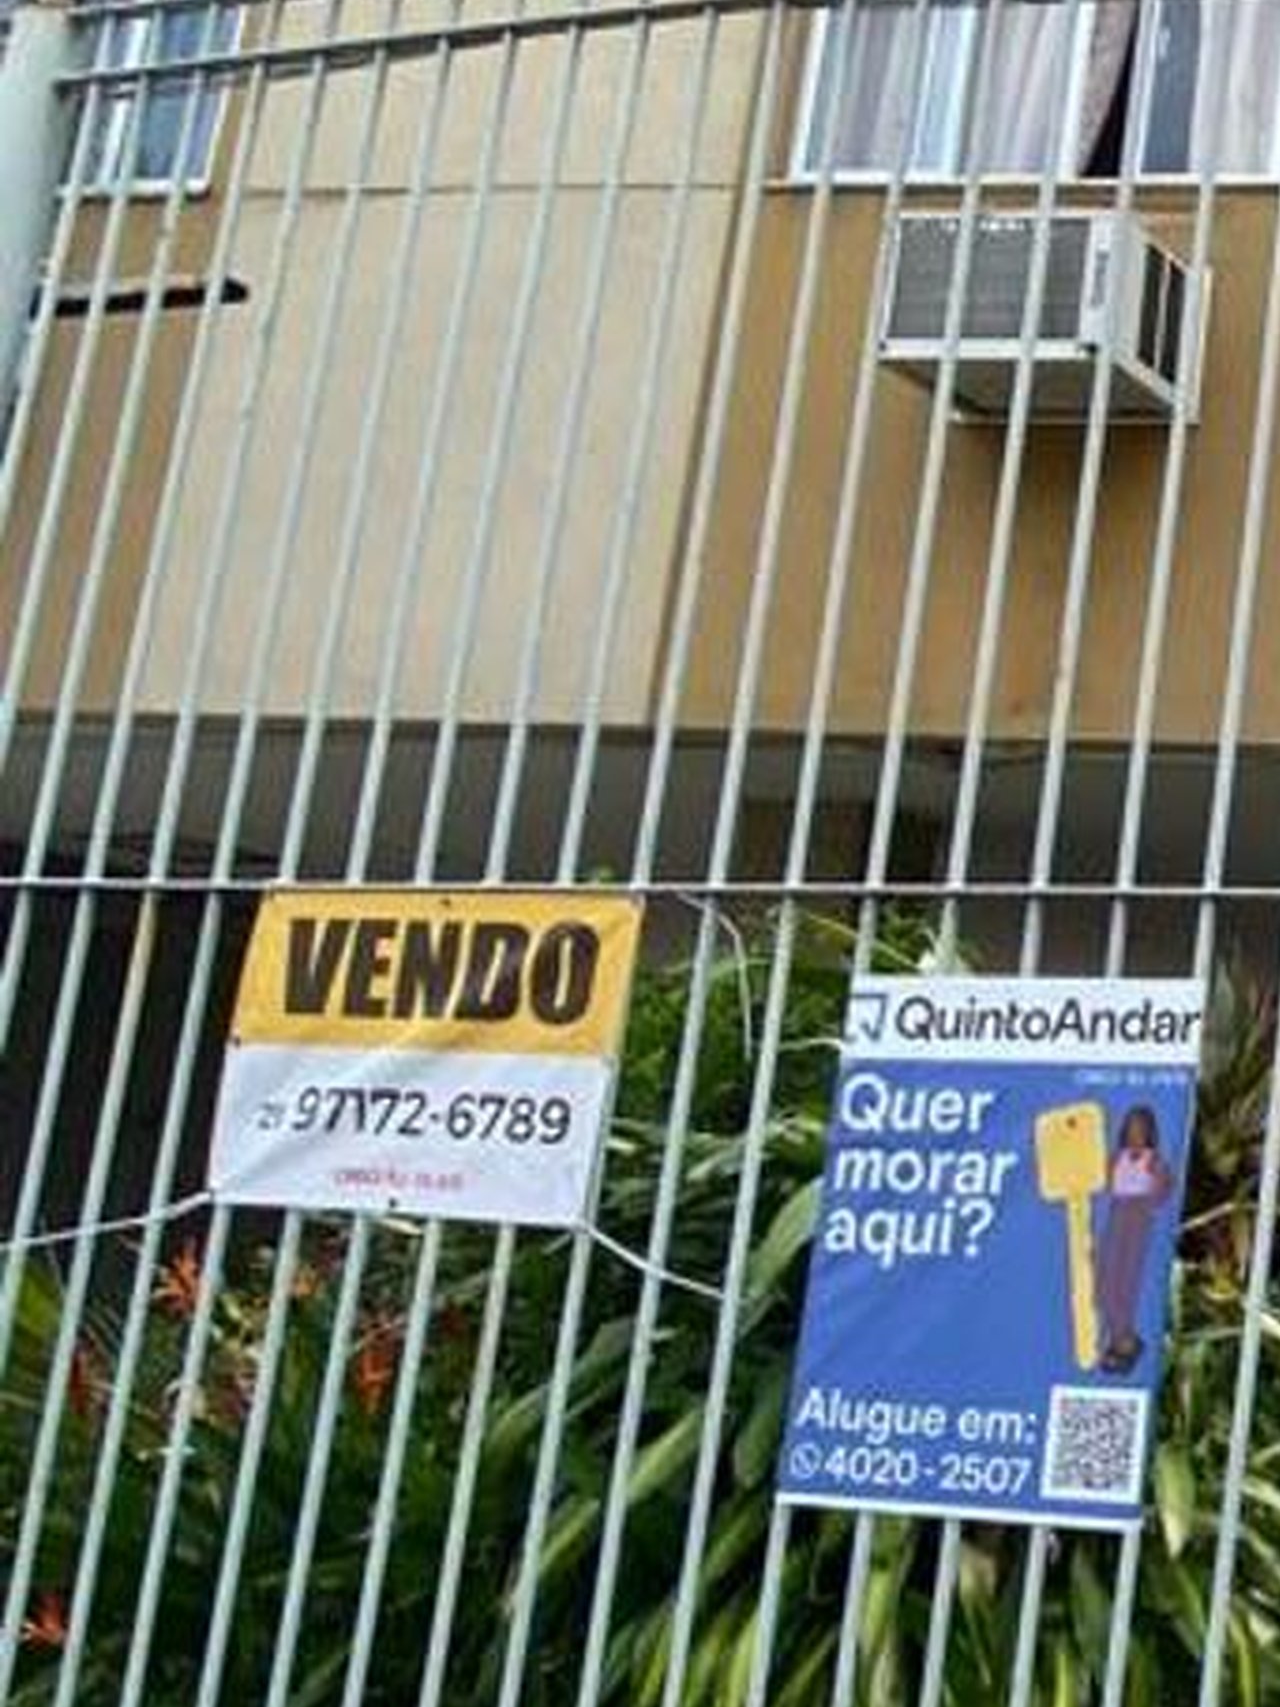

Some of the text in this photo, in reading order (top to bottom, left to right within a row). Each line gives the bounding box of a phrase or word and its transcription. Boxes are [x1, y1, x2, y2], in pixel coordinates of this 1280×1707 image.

[284, 918, 601, 1025] VENDO
[897, 996, 1201, 1045] QuintoAndar
[293, 1087, 571, 1144] 97172-6789
[840, 1073, 994, 1134] Quer
[833, 1145, 1017, 1195] morar
[824, 1198, 994, 1269] aqui?
[797, 1388, 1036, 1445] Alugue em:
